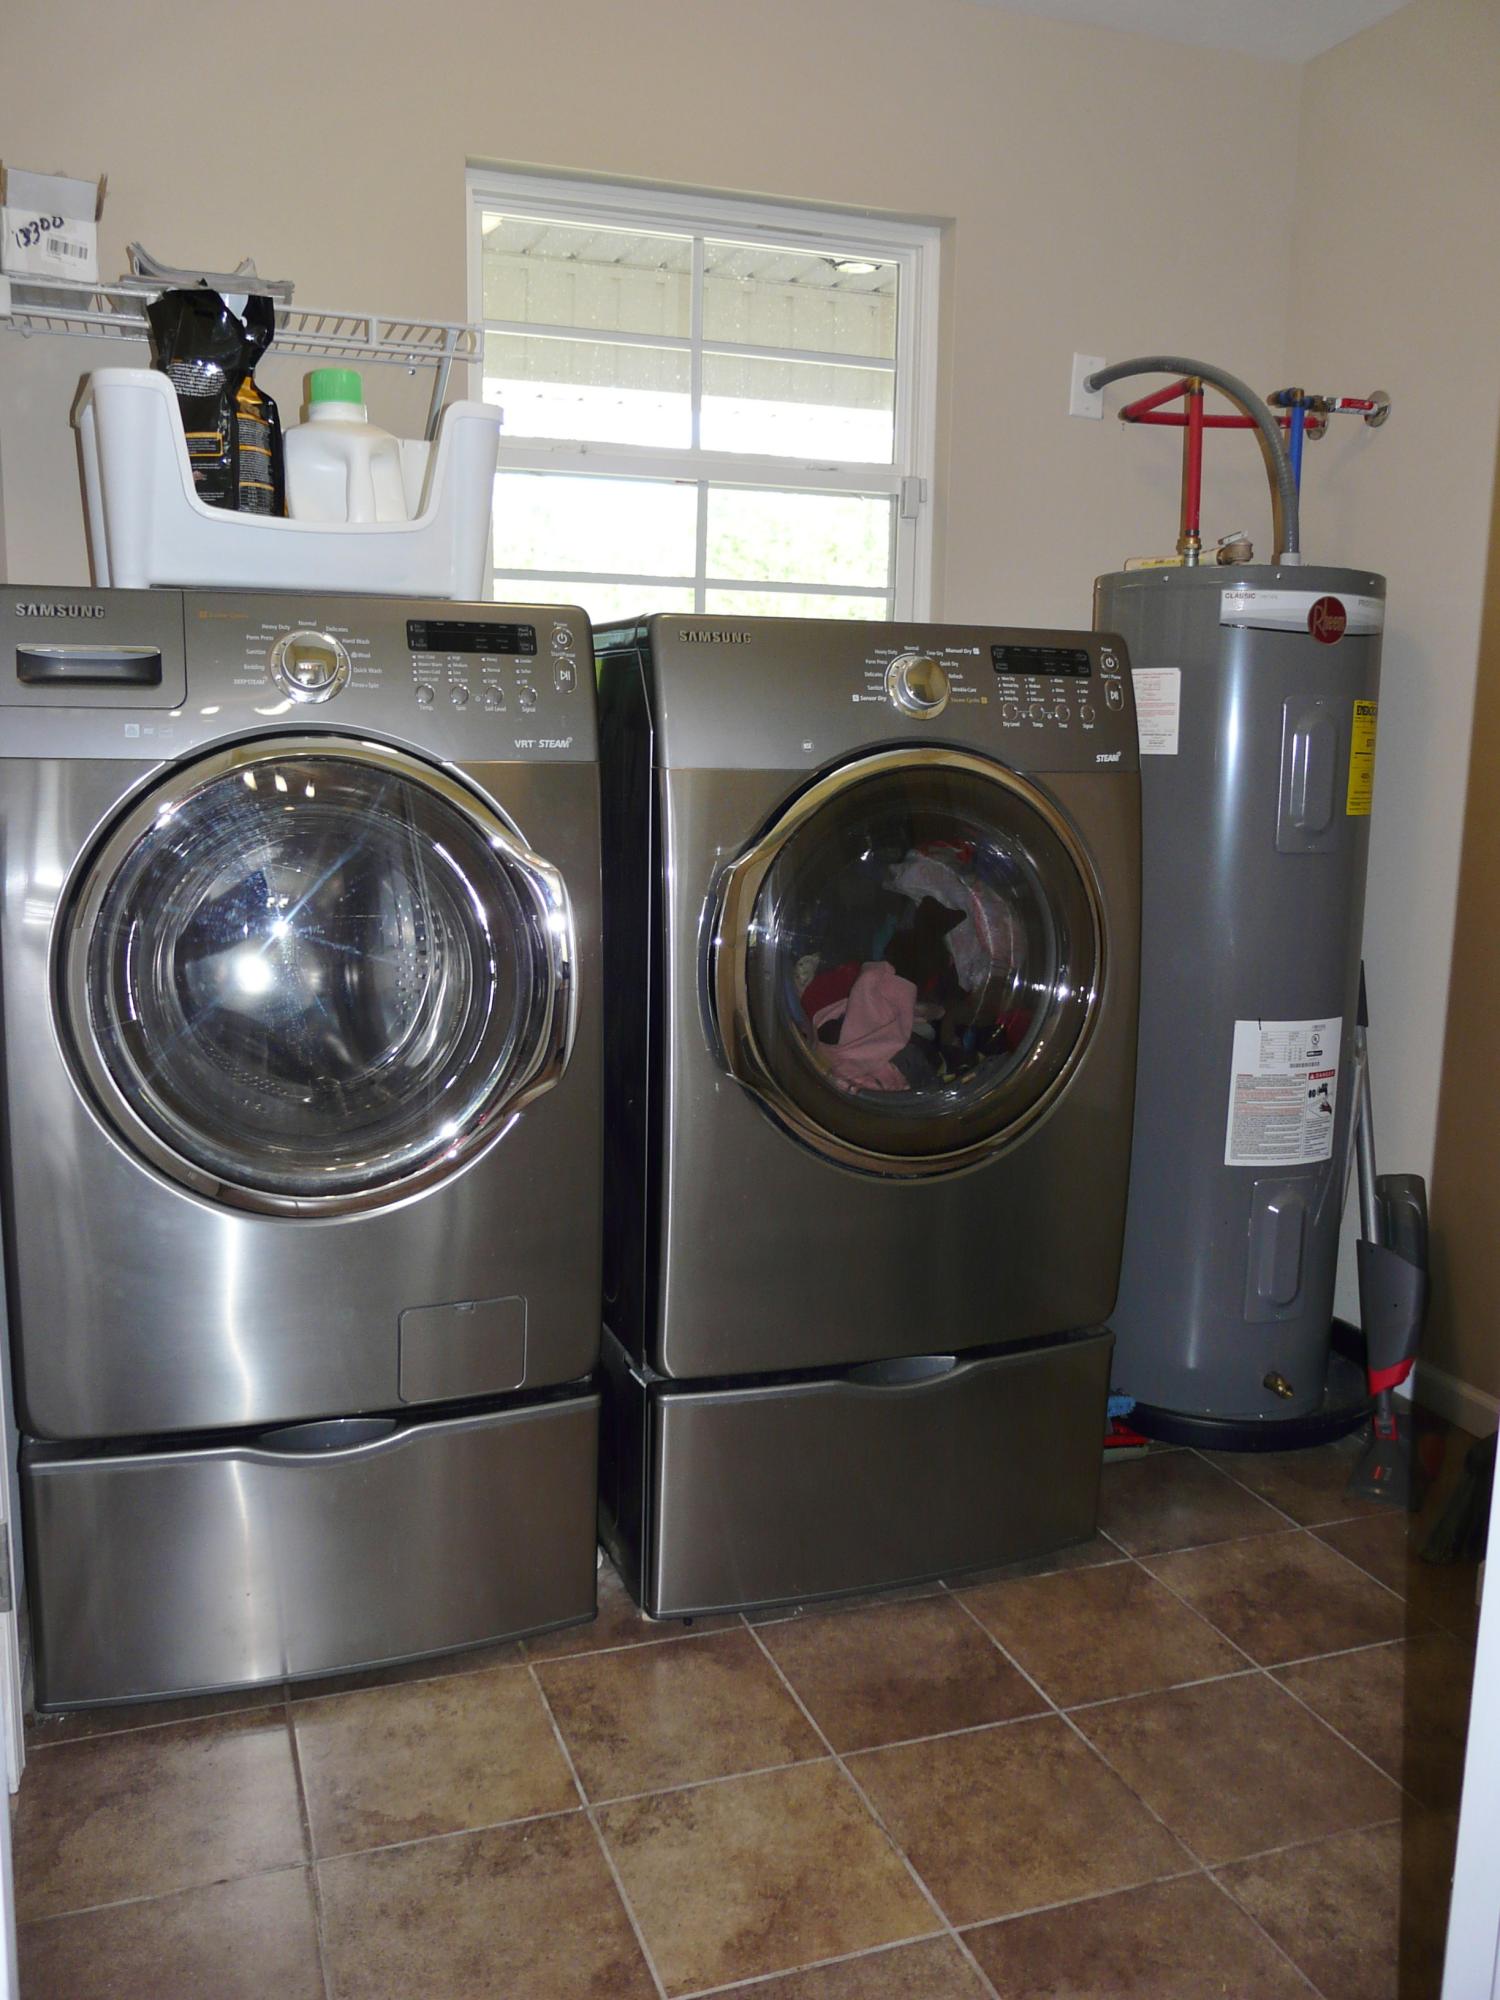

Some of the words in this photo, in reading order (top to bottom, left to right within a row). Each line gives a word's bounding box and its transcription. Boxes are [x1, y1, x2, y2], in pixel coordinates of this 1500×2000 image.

[16, 602, 104, 618] SAMSUNG
[680, 631, 752, 643] SAMSUNG
[538, 739, 570, 748] STEAM
[1096, 754, 1119, 763] STEAM
